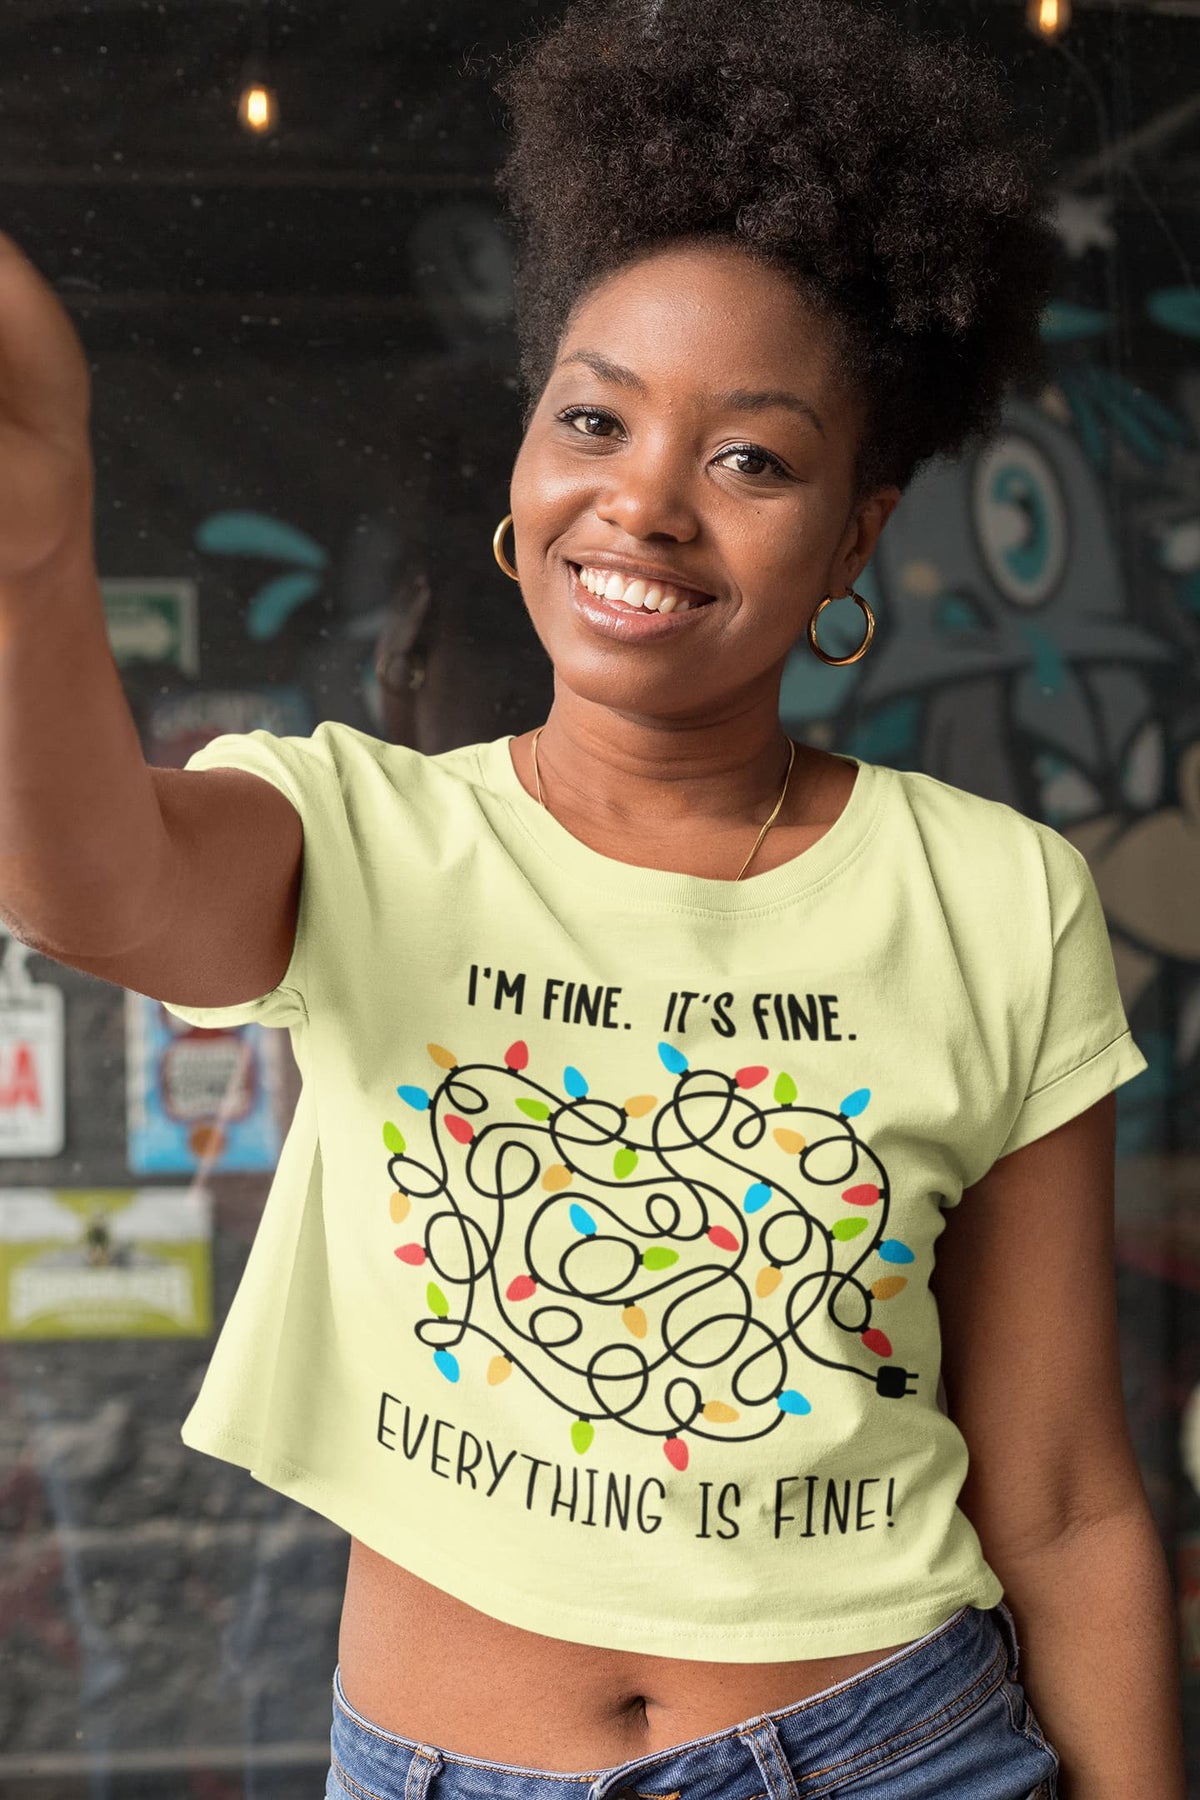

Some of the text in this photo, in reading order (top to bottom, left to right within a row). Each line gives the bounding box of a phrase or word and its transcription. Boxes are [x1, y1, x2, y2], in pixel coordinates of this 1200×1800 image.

[468, 964, 857, 1041] I'M FINE. IT'S FINE.
[377, 1391, 895, 1539] EVERYTHING IS FINE!
